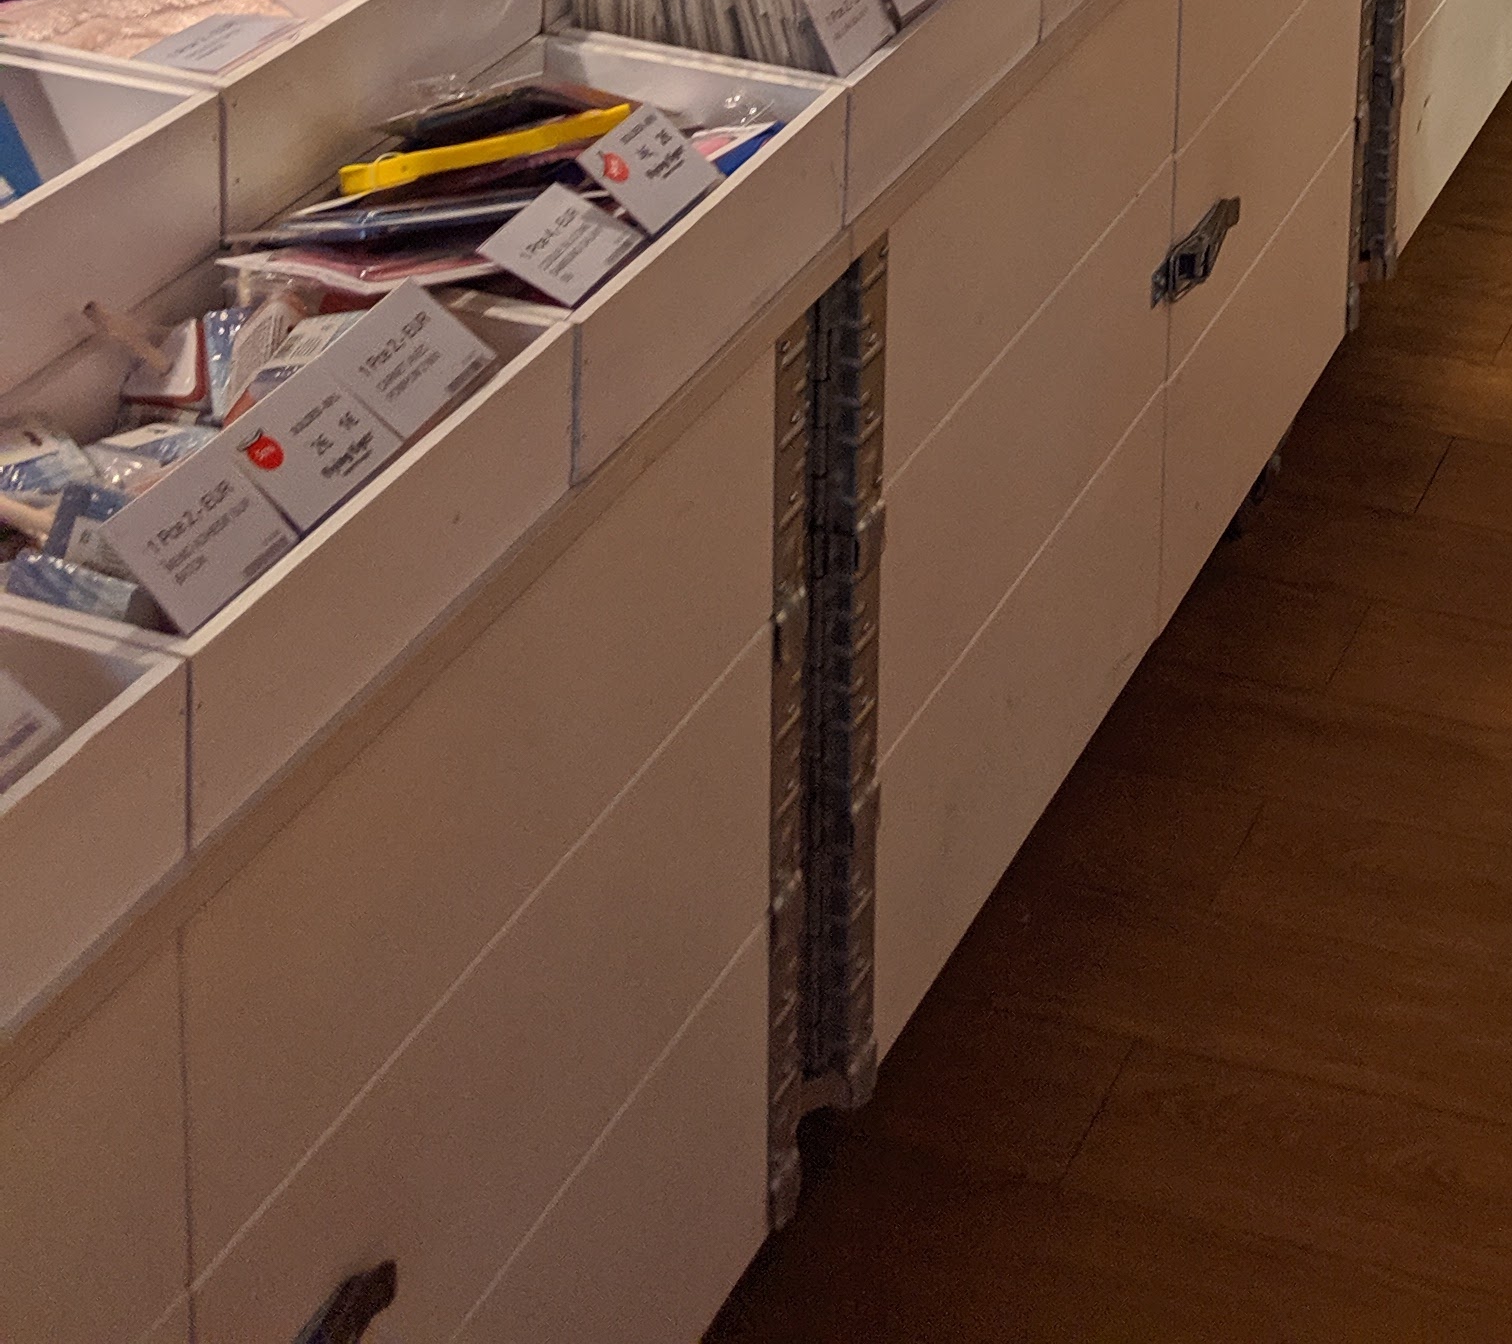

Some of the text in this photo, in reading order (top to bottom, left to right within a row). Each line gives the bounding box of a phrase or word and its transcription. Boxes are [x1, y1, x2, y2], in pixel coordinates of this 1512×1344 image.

[556, 207, 578, 227] EUR
[366, 346, 391, 370] Pce
[401, 310, 430, 338] EUR
[157, 518, 185, 545] Pce
[199, 478, 233, 510] EUR
